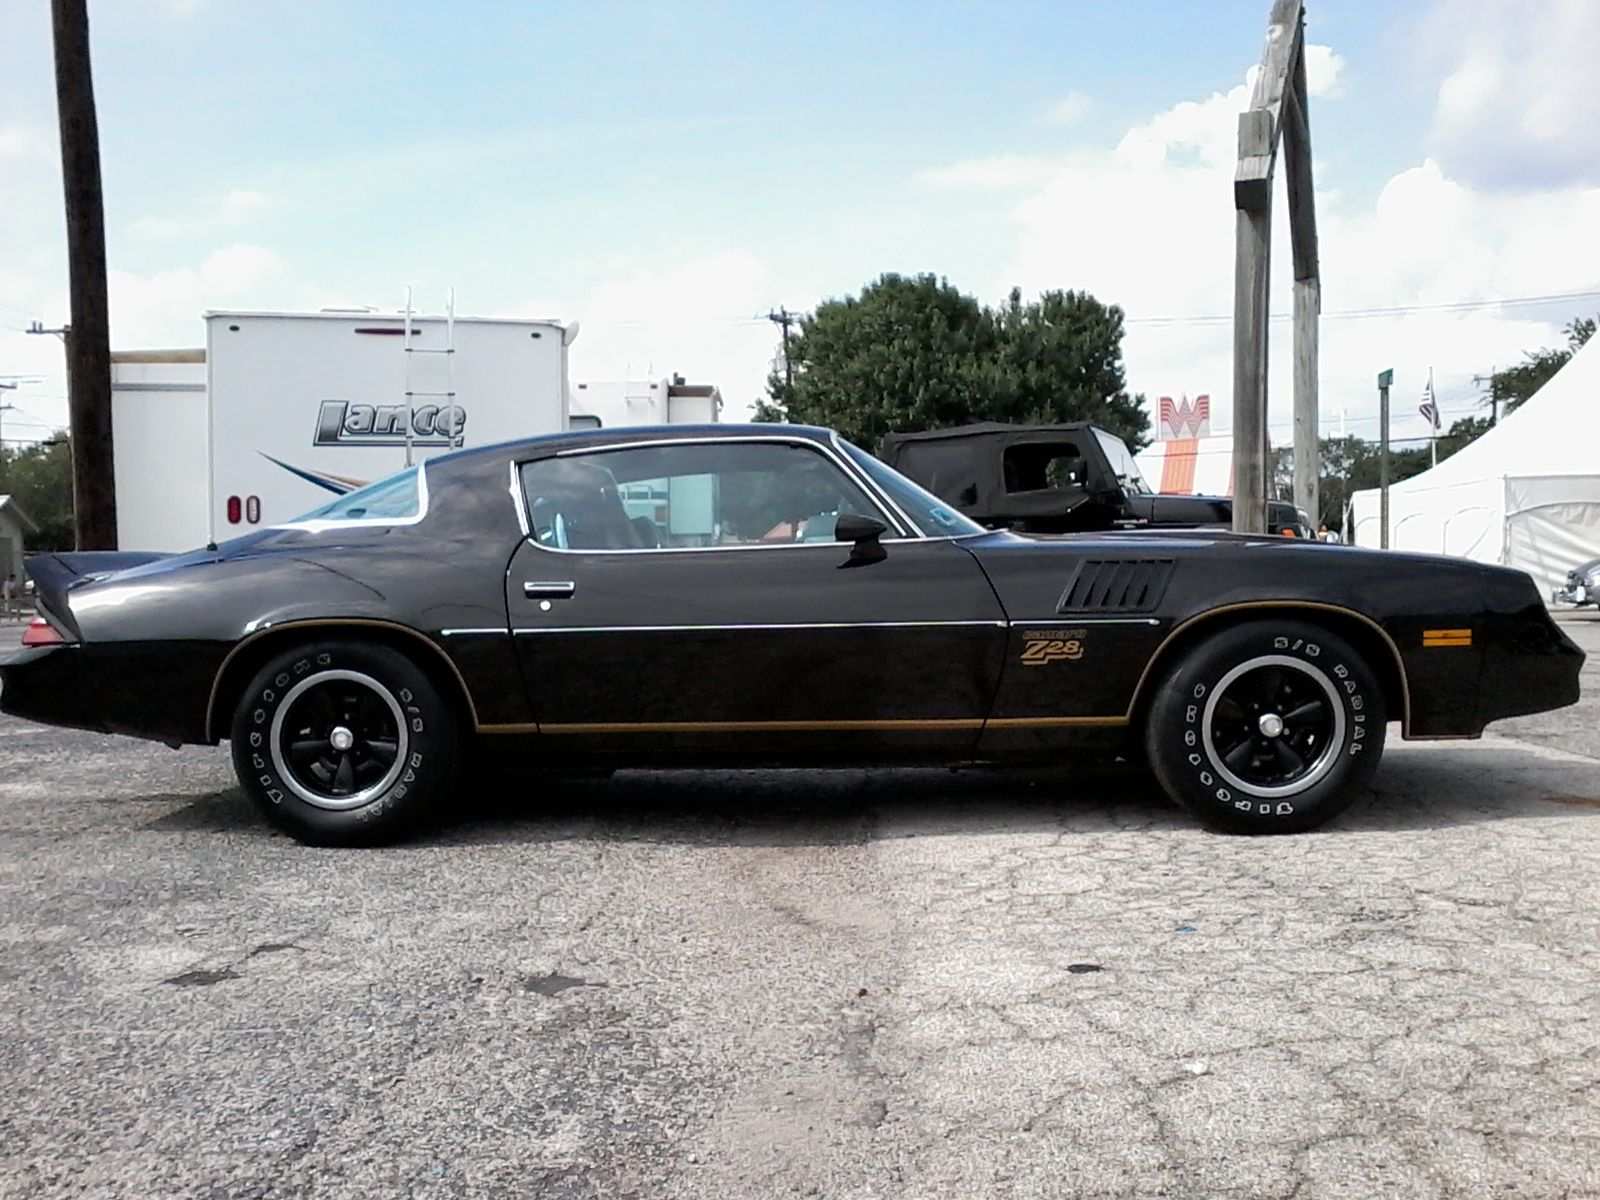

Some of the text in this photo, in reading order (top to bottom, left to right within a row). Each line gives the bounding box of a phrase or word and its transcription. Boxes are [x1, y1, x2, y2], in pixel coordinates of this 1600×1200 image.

[313, 400, 466, 447] Lance
[1020, 640, 1083, 665] Z28
[1334, 663, 1366, 755] RADIAL
